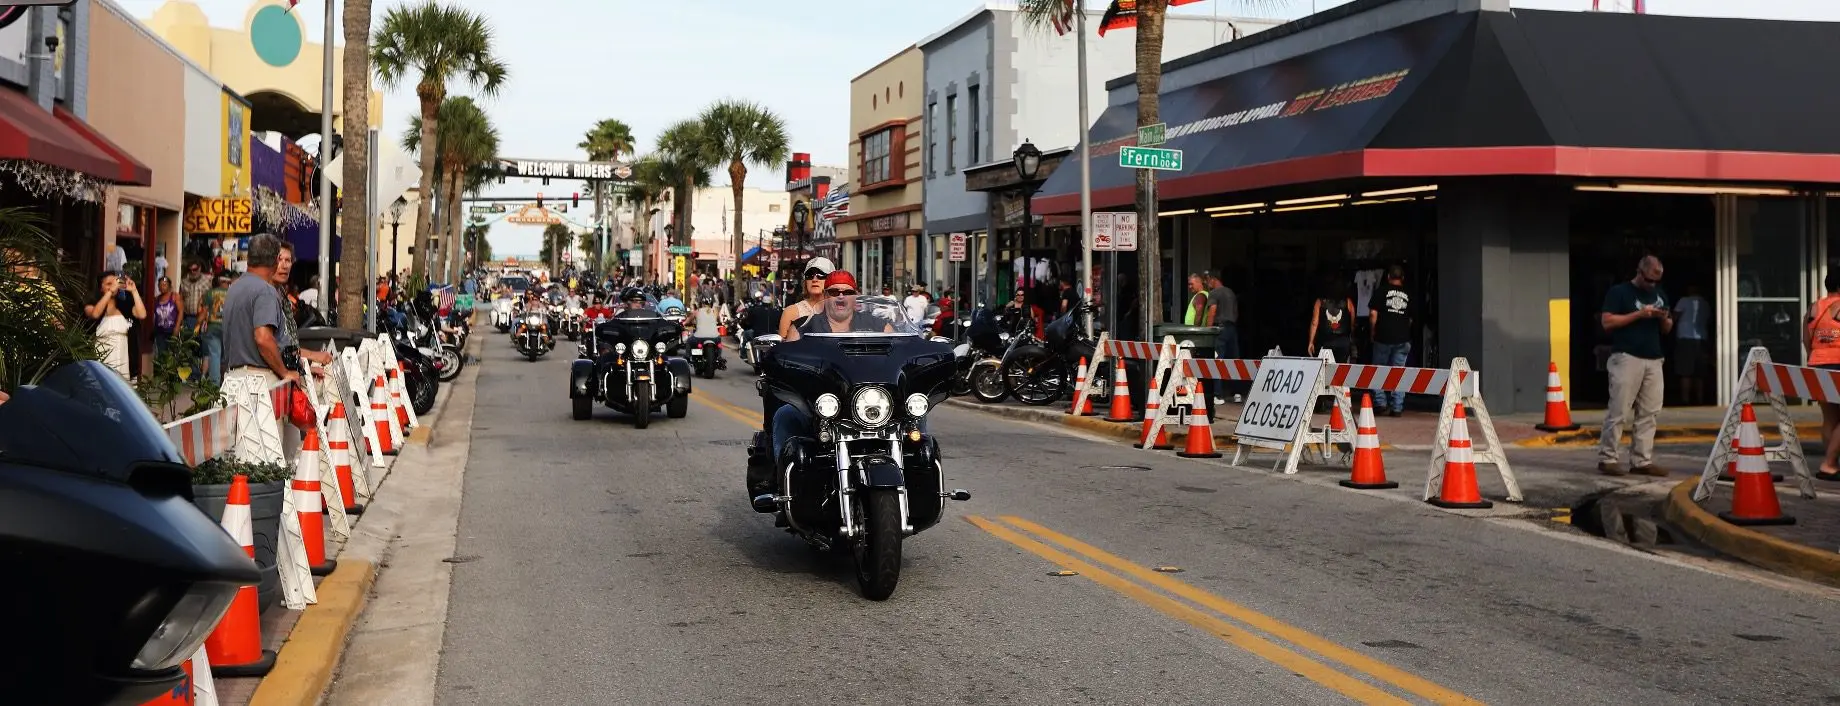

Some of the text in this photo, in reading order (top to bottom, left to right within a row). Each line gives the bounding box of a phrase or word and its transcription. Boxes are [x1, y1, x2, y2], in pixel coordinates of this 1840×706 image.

[1187, 111, 1247, 134] MOTORCYCLE
[1240, 100, 1287, 123] APPAREL
[1139, 128, 1153, 145] Main
[1122, 148, 1171, 166] S Fern Ln
[517, 160, 569, 177] WELCOME
[573, 165, 612, 178] RIDERS
[184, 199, 251, 216] PATCHES
[184, 214, 251, 232] SEWING
[1121, 215, 1130, 223] NO
[1261, 369, 1305, 394] ROAD
[1243, 401, 1300, 429] CLOSED
